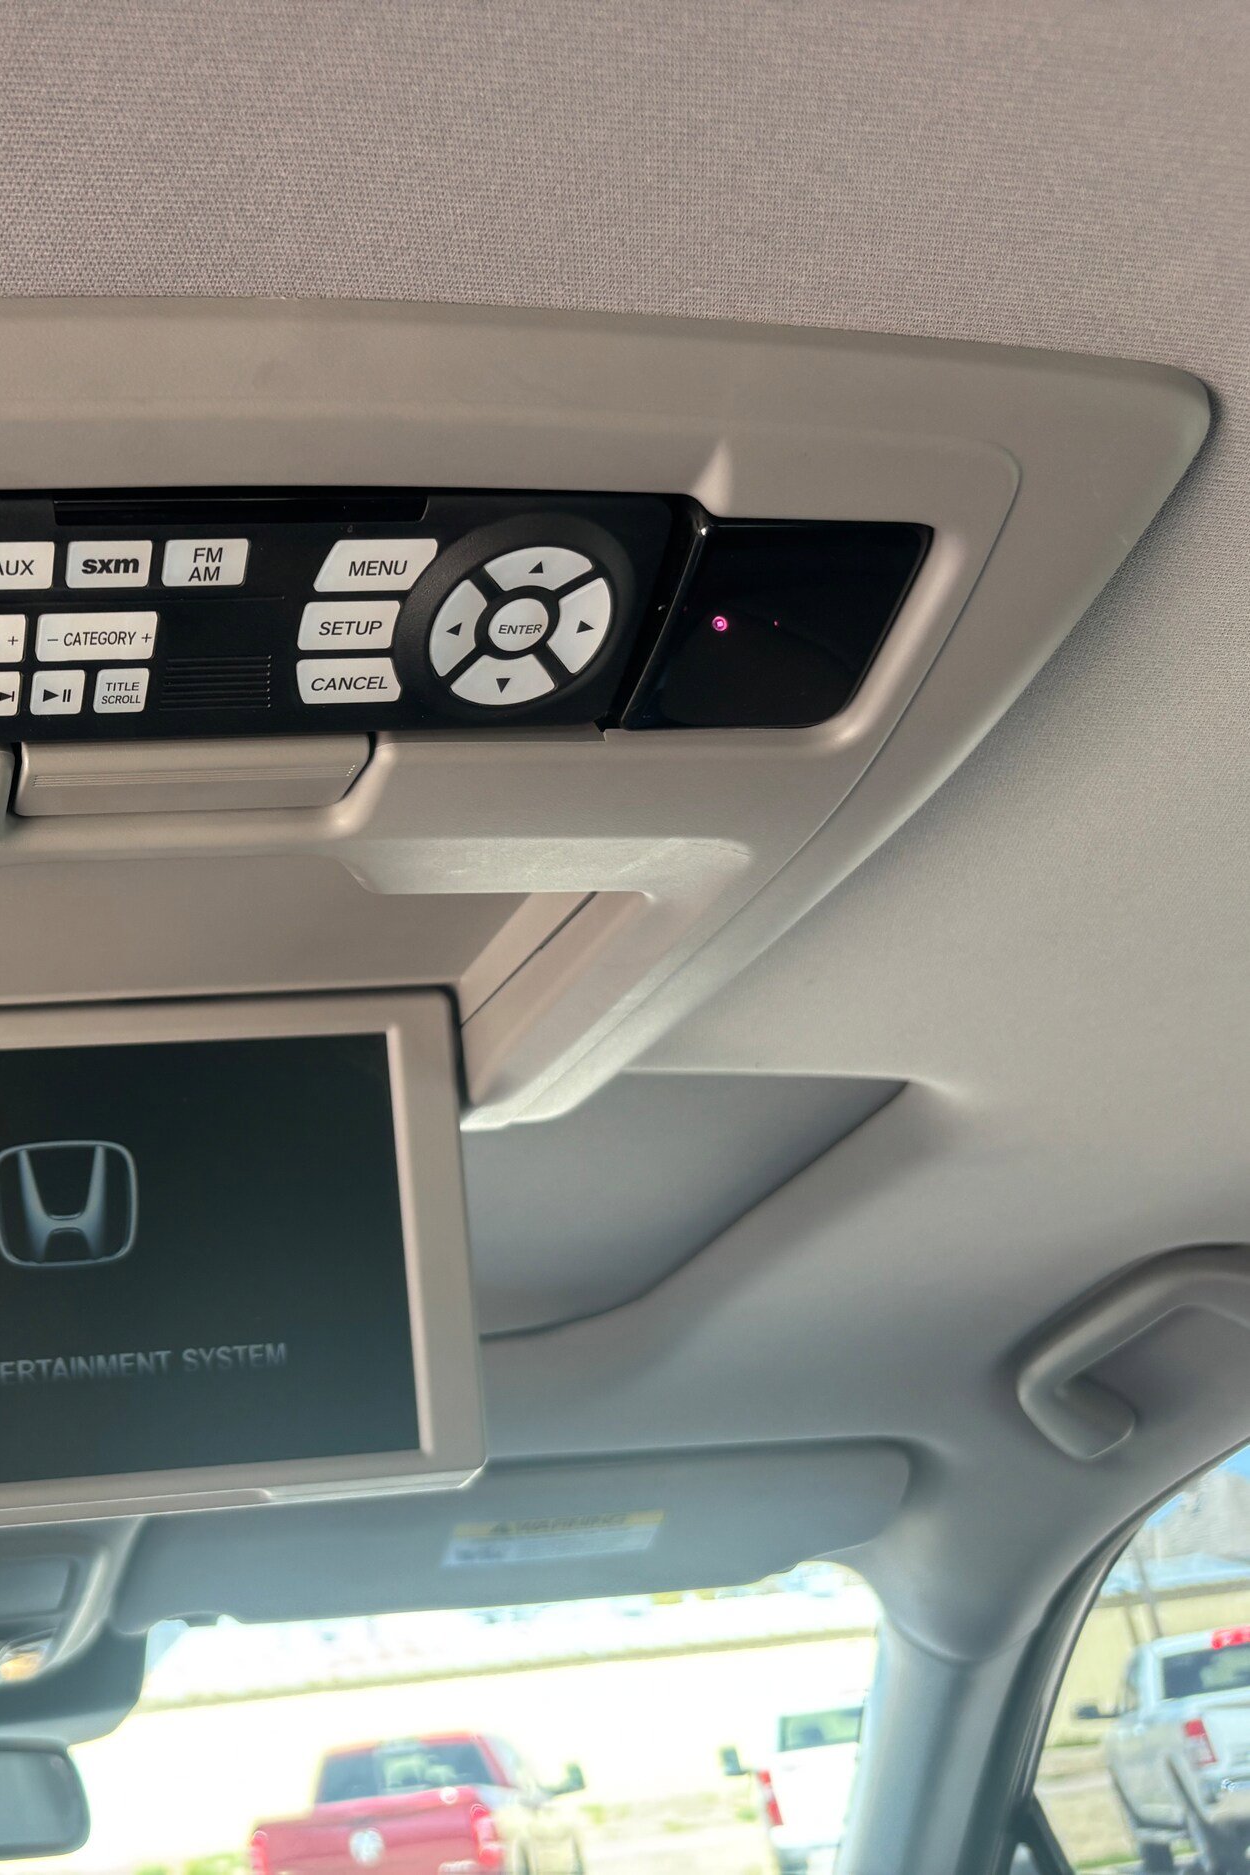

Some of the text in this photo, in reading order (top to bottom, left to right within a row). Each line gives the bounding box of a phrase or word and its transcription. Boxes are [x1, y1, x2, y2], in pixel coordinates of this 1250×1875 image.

[193, 547, 224, 563] FM
[81, 556, 140, 575] sxm
[188, 566, 221, 582] AM
[348, 560, 408, 577] MENU
[318, 620, 383, 637] SETUP
[498, 623, 543, 636] ENTER
[63, 631, 137, 648] CATEGORY
[105, 681, 140, 692] TITLE
[310, 675, 389, 692] CANCEL
[101, 694, 141, 706] SCROLL
[181, 1342, 288, 1373] SYSTEM
